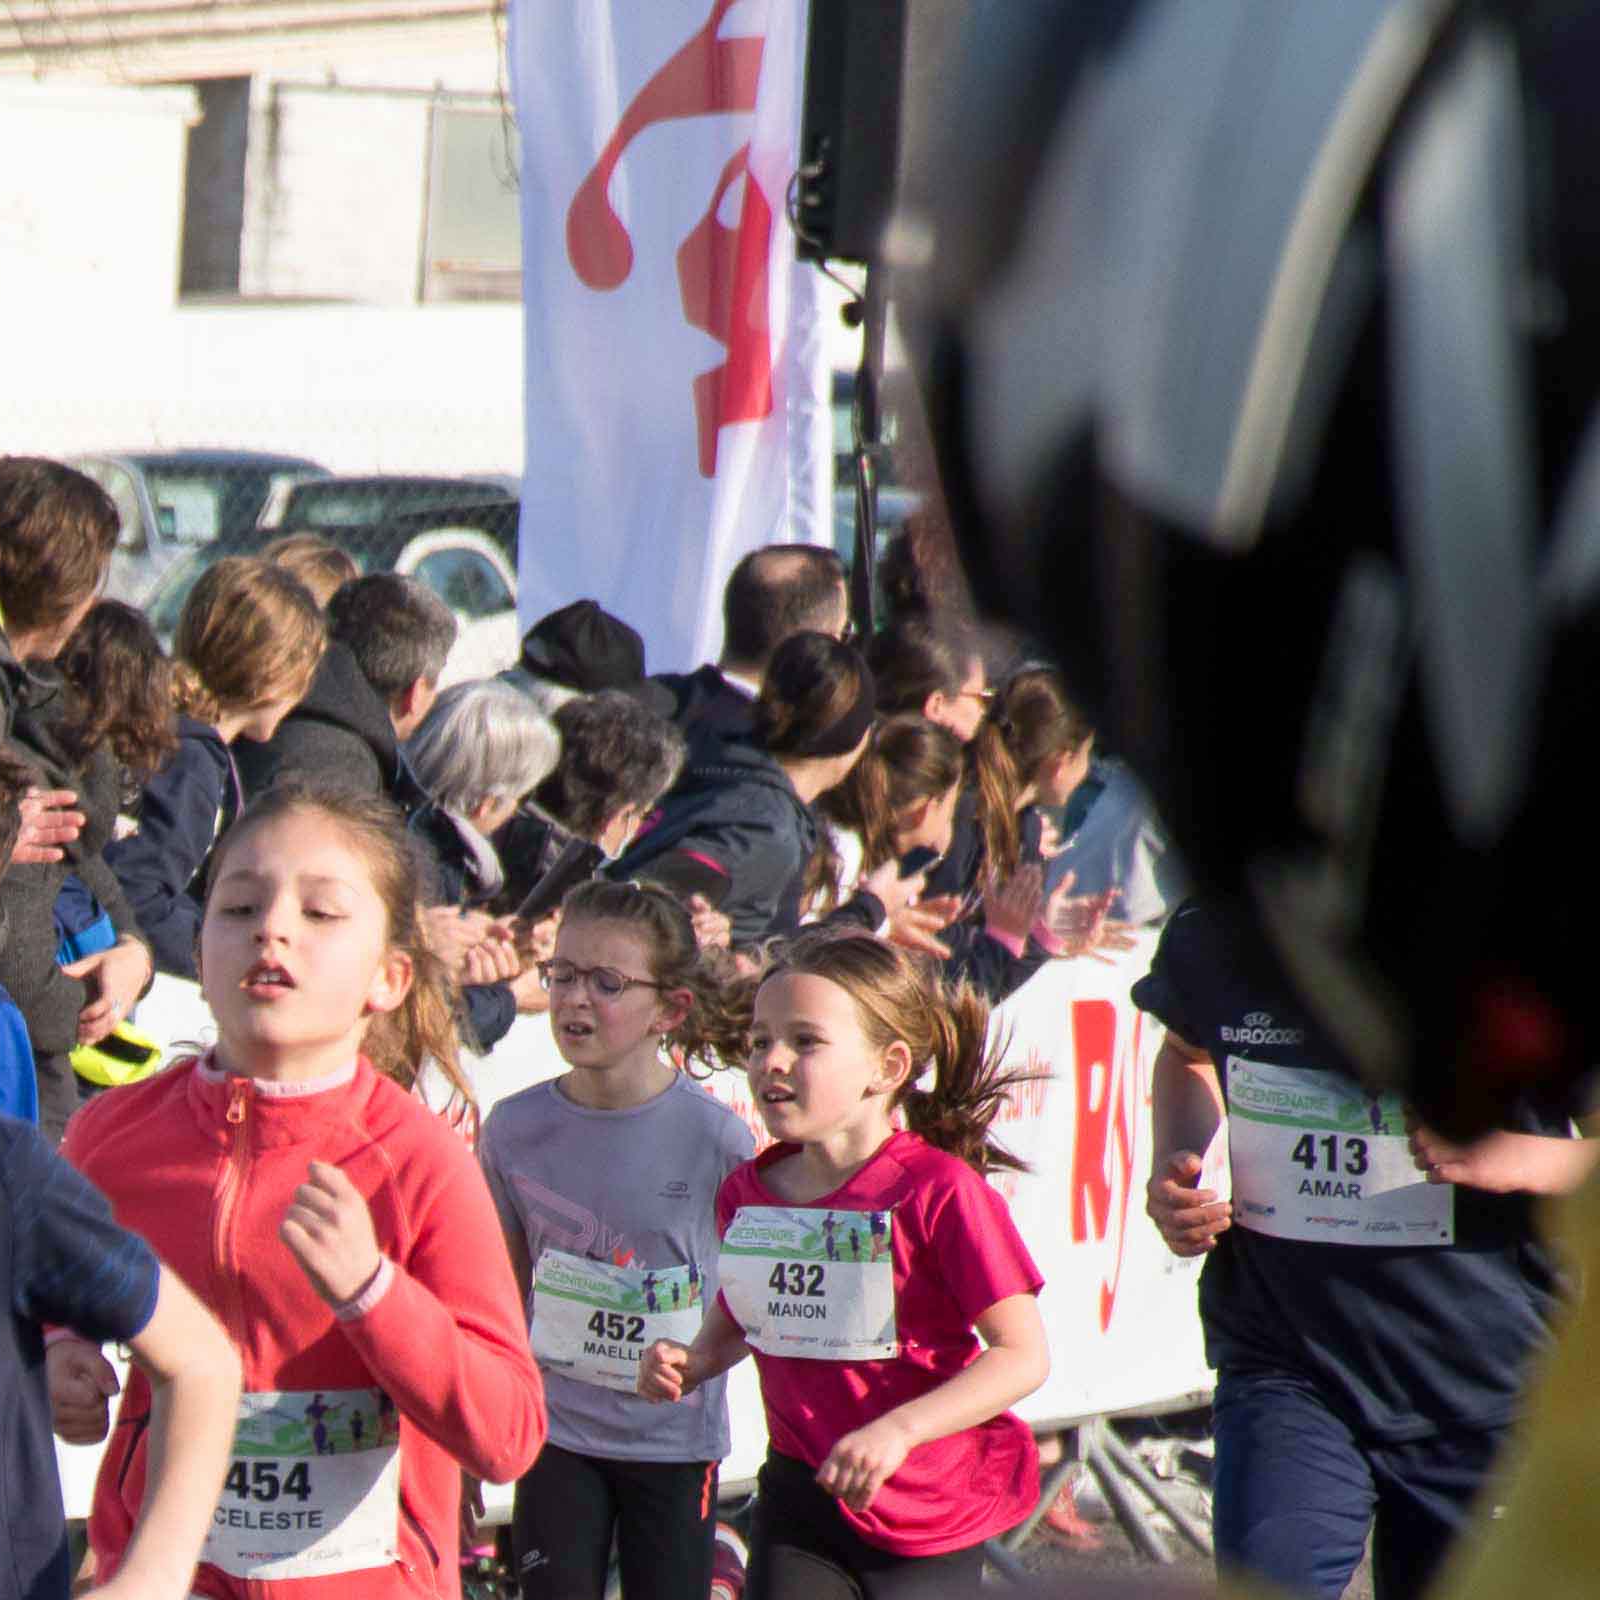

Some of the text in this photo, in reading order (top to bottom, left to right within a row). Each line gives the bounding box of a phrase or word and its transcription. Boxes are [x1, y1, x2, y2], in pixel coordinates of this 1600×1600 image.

[1291, 1133, 1369, 1176] 413
[1298, 1179, 1361, 1200] AMAR
[768, 1262, 825, 1297] 432
[588, 1310, 645, 1343] 452
[767, 1301, 827, 1319] MANON
[224, 1461, 312, 1502] 454
[213, 1507, 324, 1530] CELESTE
